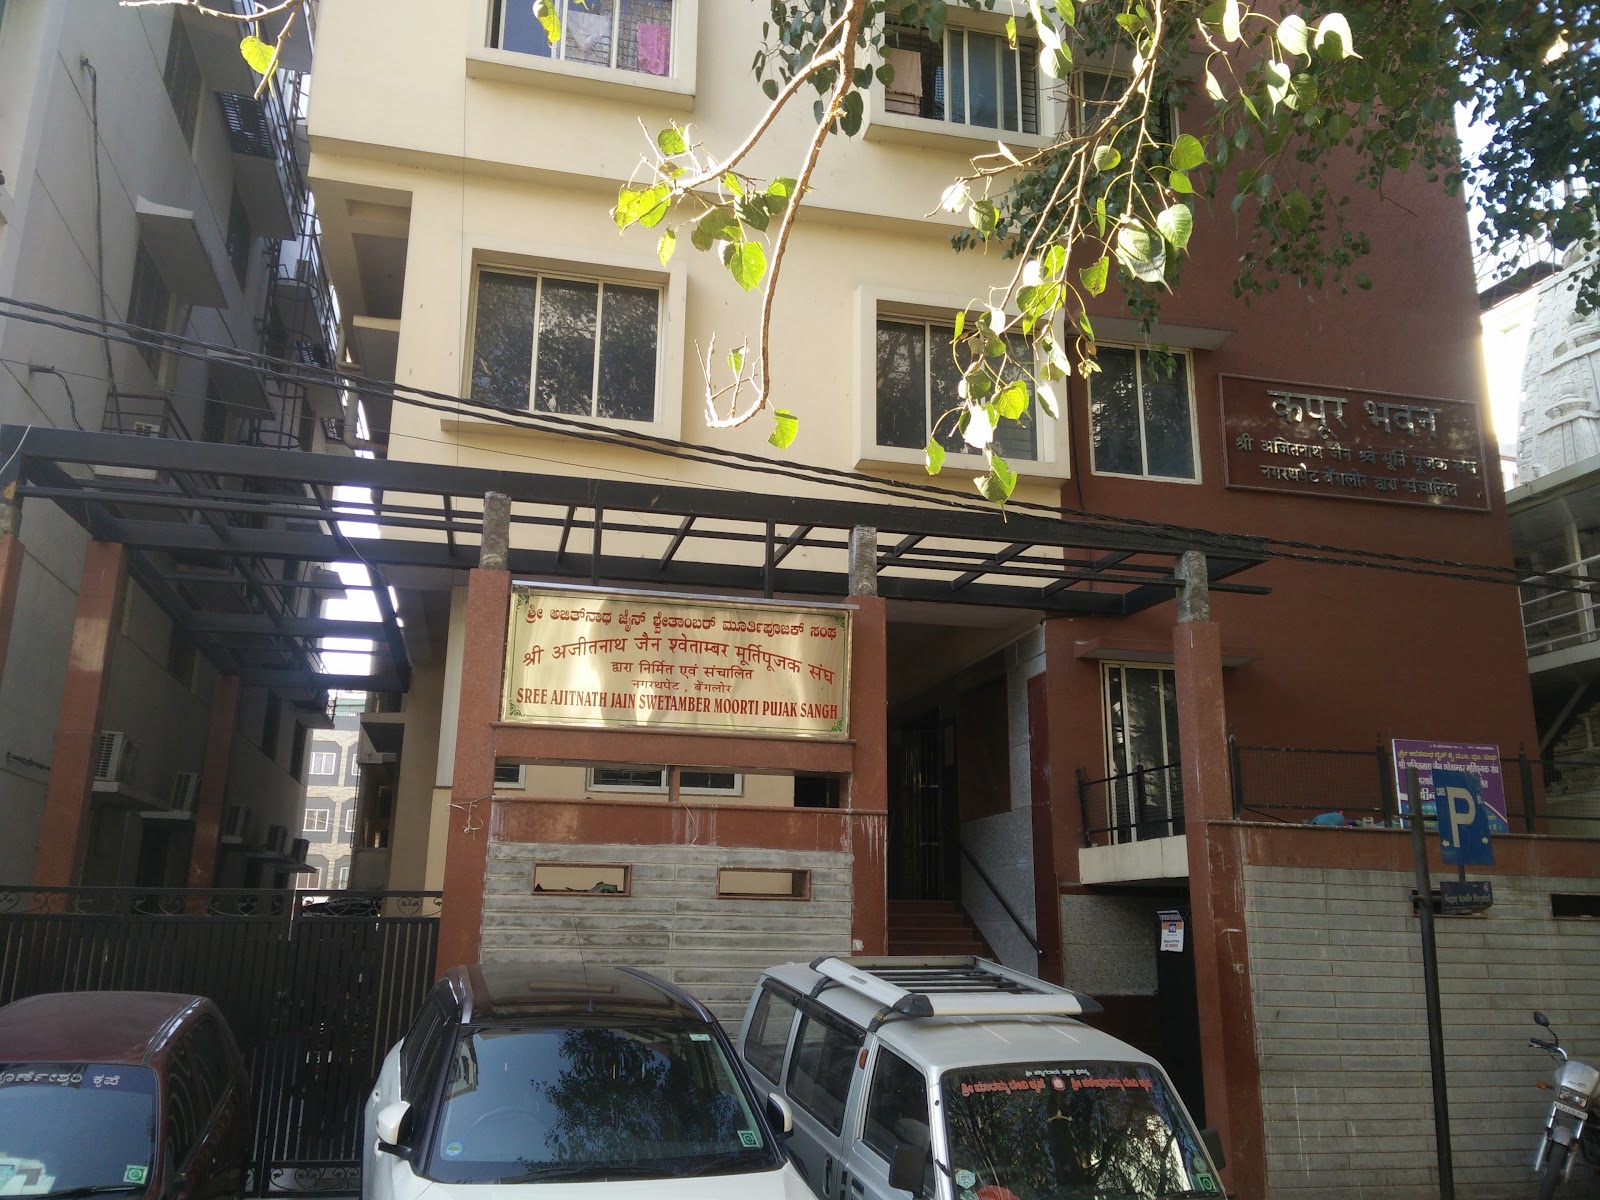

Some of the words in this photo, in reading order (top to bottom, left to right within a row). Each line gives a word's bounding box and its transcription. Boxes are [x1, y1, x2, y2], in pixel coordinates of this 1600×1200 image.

[1267, 389, 1349, 440] कपूर
[1363, 400, 1442, 440] भवन
[1236, 433, 1254, 451] श्री
[1260, 436, 1324, 459] अजितनाथ
[1328, 442, 1352, 461] जैन
[526, 604, 543, 623] ಶ್ರೀ
[618, 609, 646, 632] ಜೈನ್
[810, 625, 837, 640] ಸಂಘ
[523, 645, 544, 666] श्री
[552, 636, 628, 659] अजीतनाथ
[634, 632, 662, 652] जैन
[668, 633, 729, 658] श्वेताम्बर
[734, 643, 803, 673] मूर्तिपूजक
[808, 663, 836, 686] संघ
[611, 662, 634, 673] द्वारा
[638, 660, 675, 675] निर्मित
[679, 664, 699, 679] एवं
[703, 665, 754, 680] संचालित
[516, 687, 548, 705] SREE
[550, 689, 607, 708] AJITNATH
[610, 693, 636, 709] JAIN
[639, 694, 711, 713] SWETAMBER
[714, 698, 759, 716] MOORTI
[762, 701, 798, 718] PUJAK
[800, 703, 838, 720] SANGH
[1447, 786, 1476, 848] P
[92, 1073, 121, 1088] ಕೃಪೆ
